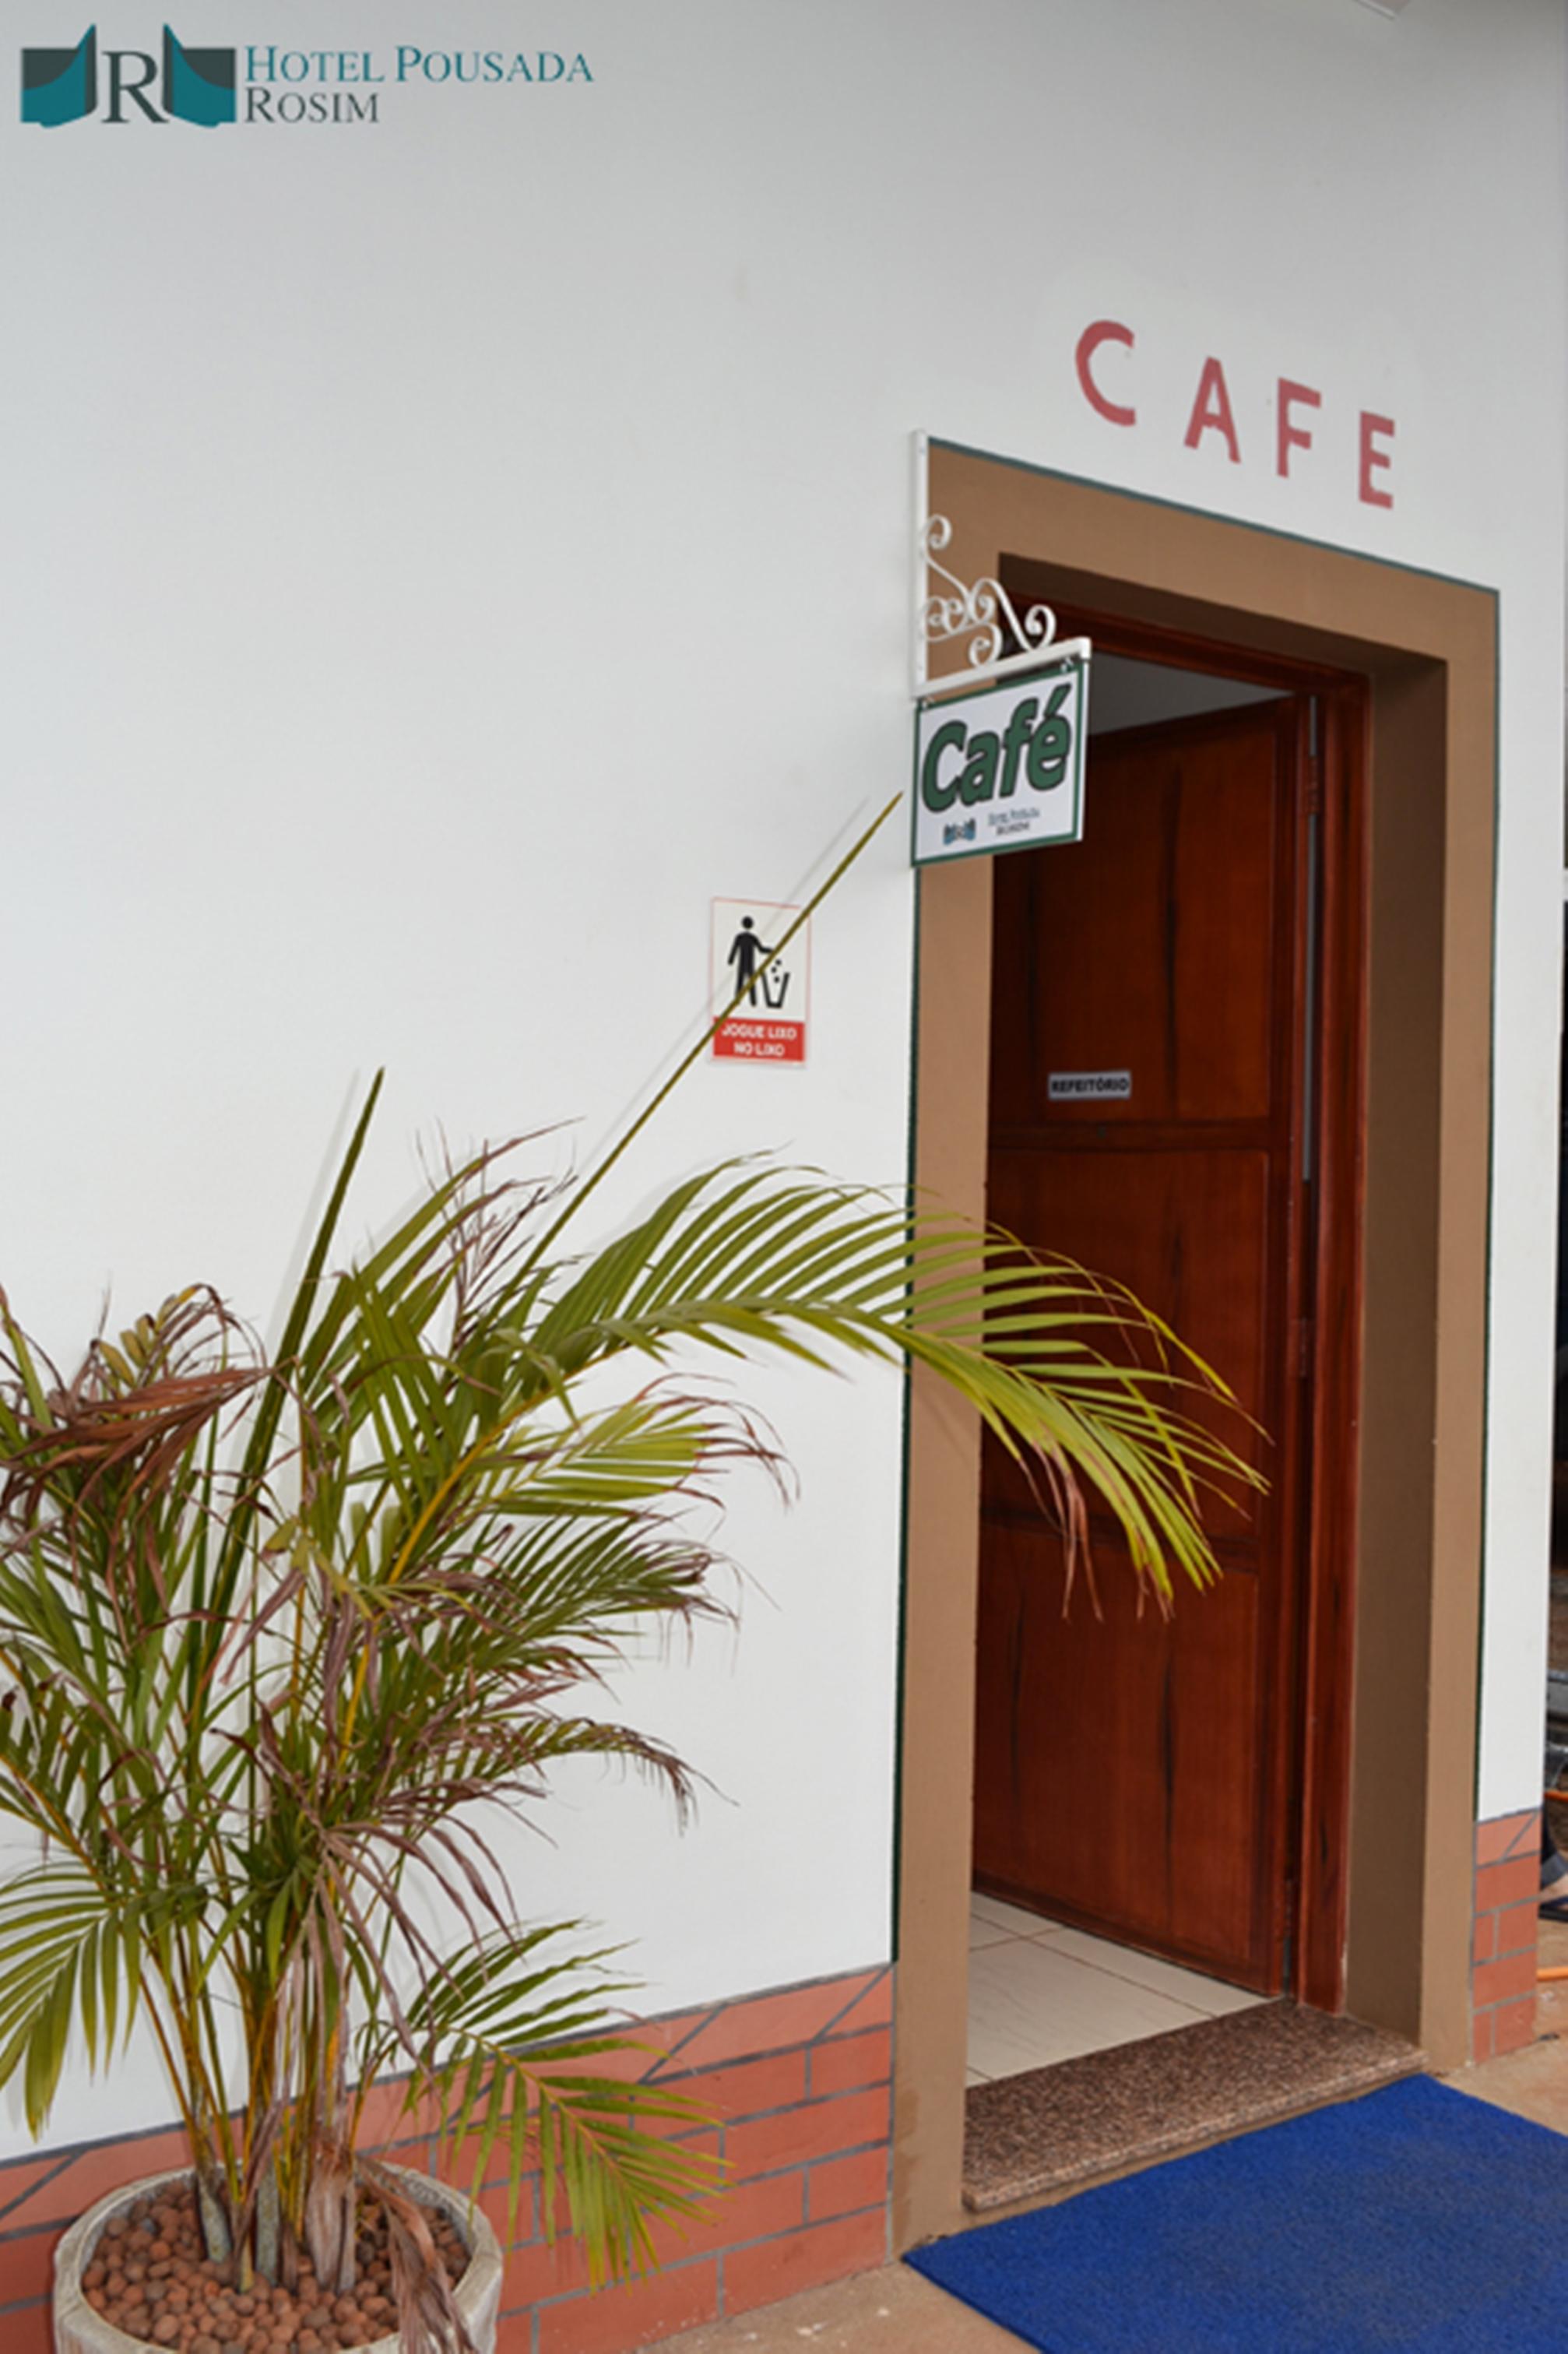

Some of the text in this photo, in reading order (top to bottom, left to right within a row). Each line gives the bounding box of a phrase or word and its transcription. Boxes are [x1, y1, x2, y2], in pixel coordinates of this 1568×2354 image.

[1076, 319, 1395, 509] CAFE
[922, 682, 1073, 813] Café
[722, 1023, 764, 1038] JOGUE
[734, 1041, 786, 1057] NO LIXO
